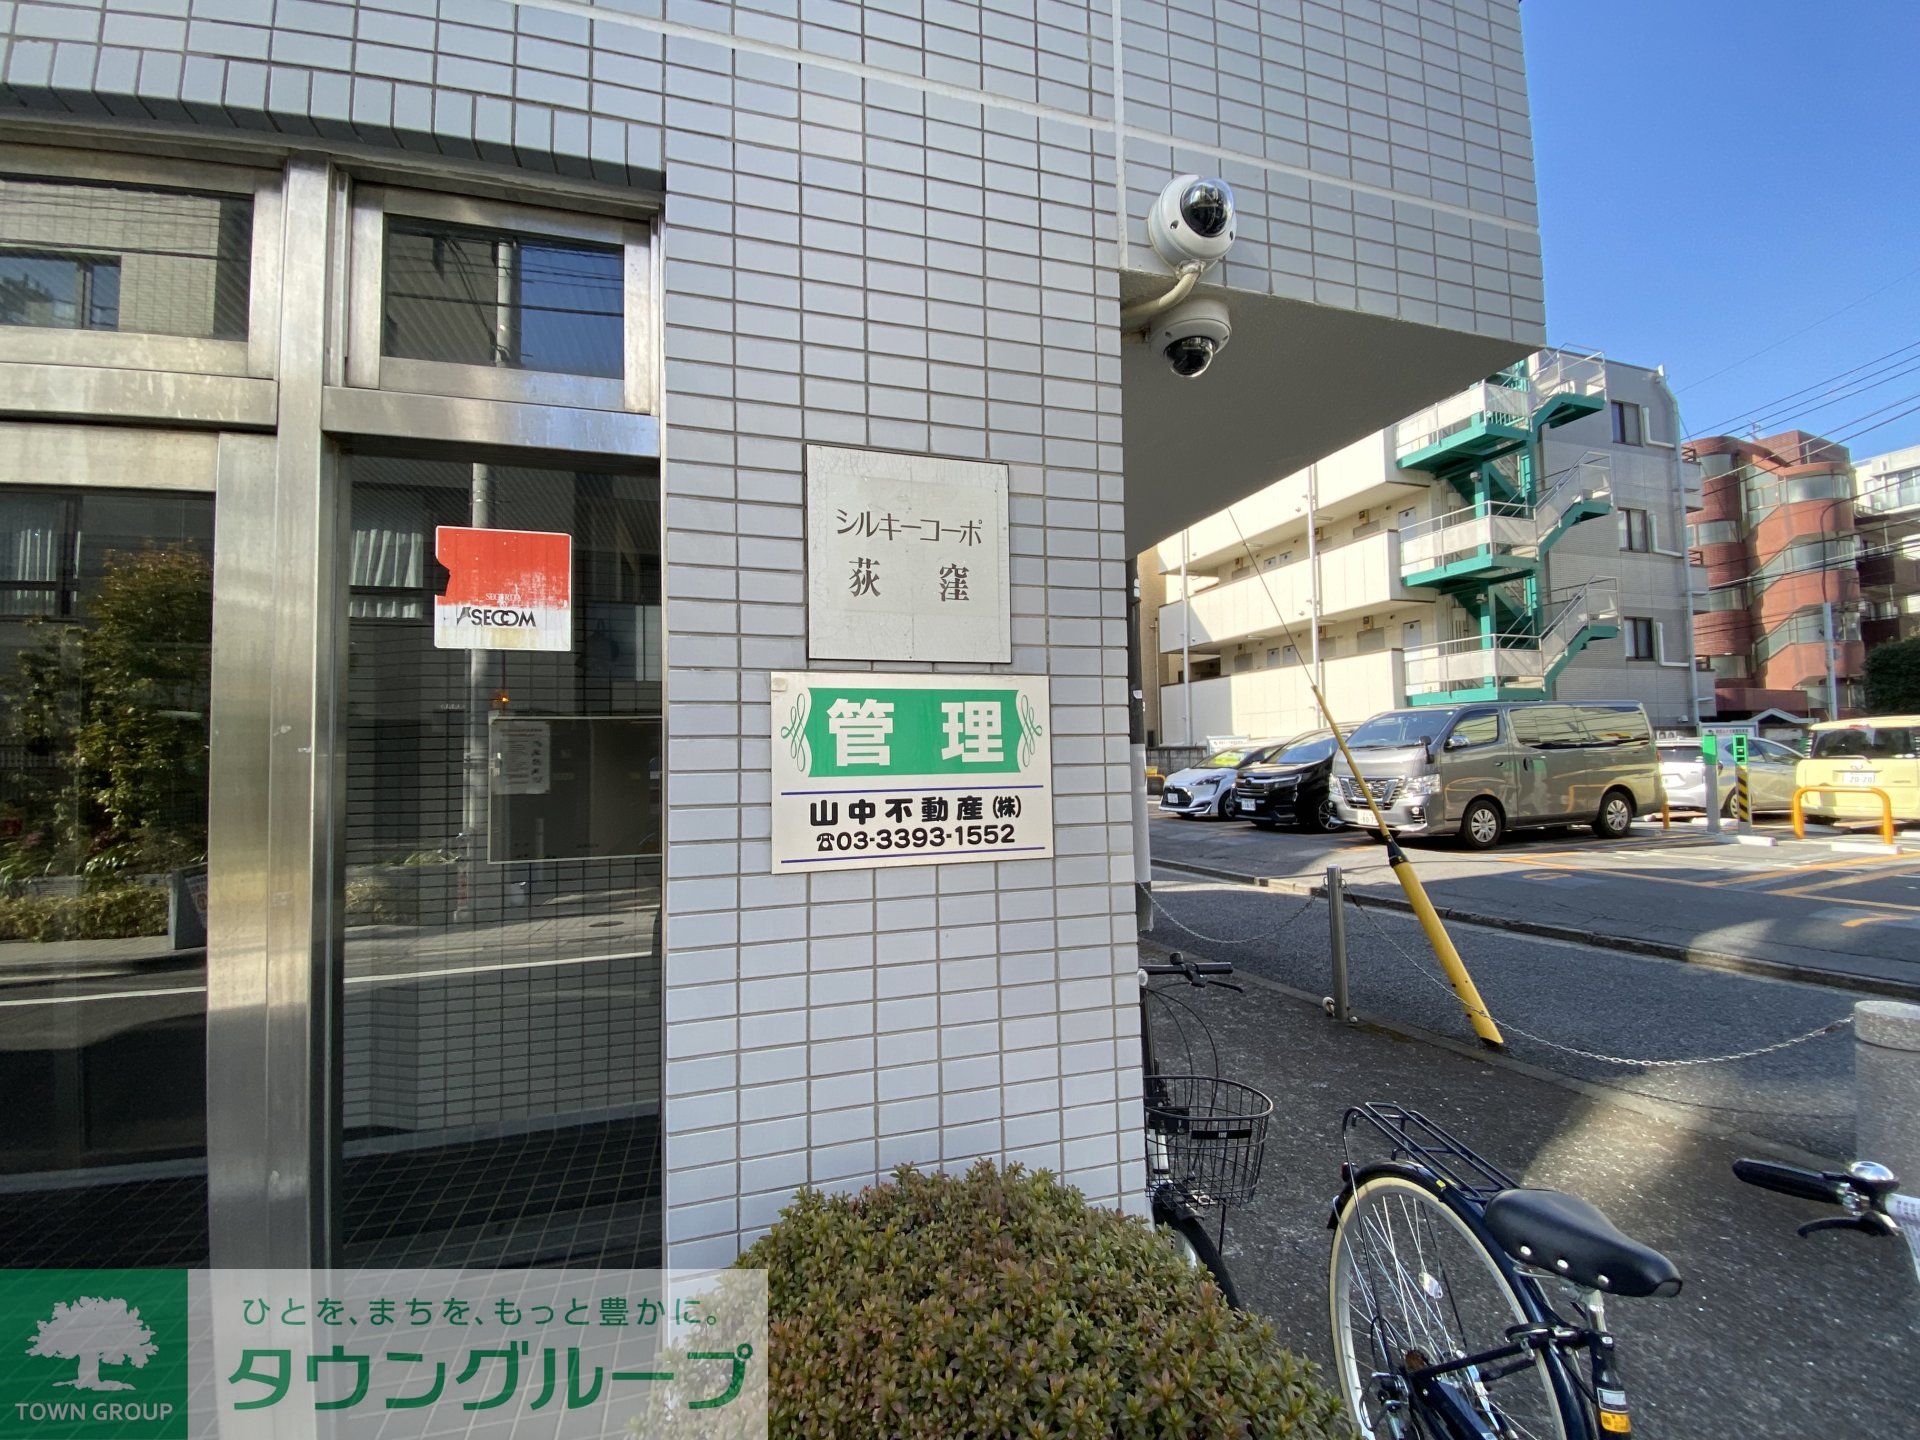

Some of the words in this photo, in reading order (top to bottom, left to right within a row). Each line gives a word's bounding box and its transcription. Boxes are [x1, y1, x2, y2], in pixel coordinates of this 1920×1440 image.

[836, 509, 983, 547] シルキーコーポ
[471, 609, 537, 627] SECOM
[826, 698, 1004, 767] 管理
[809, 794, 1023, 826] 山中不動産(株)
[835, 824, 1016, 851] 03-3393-1552
